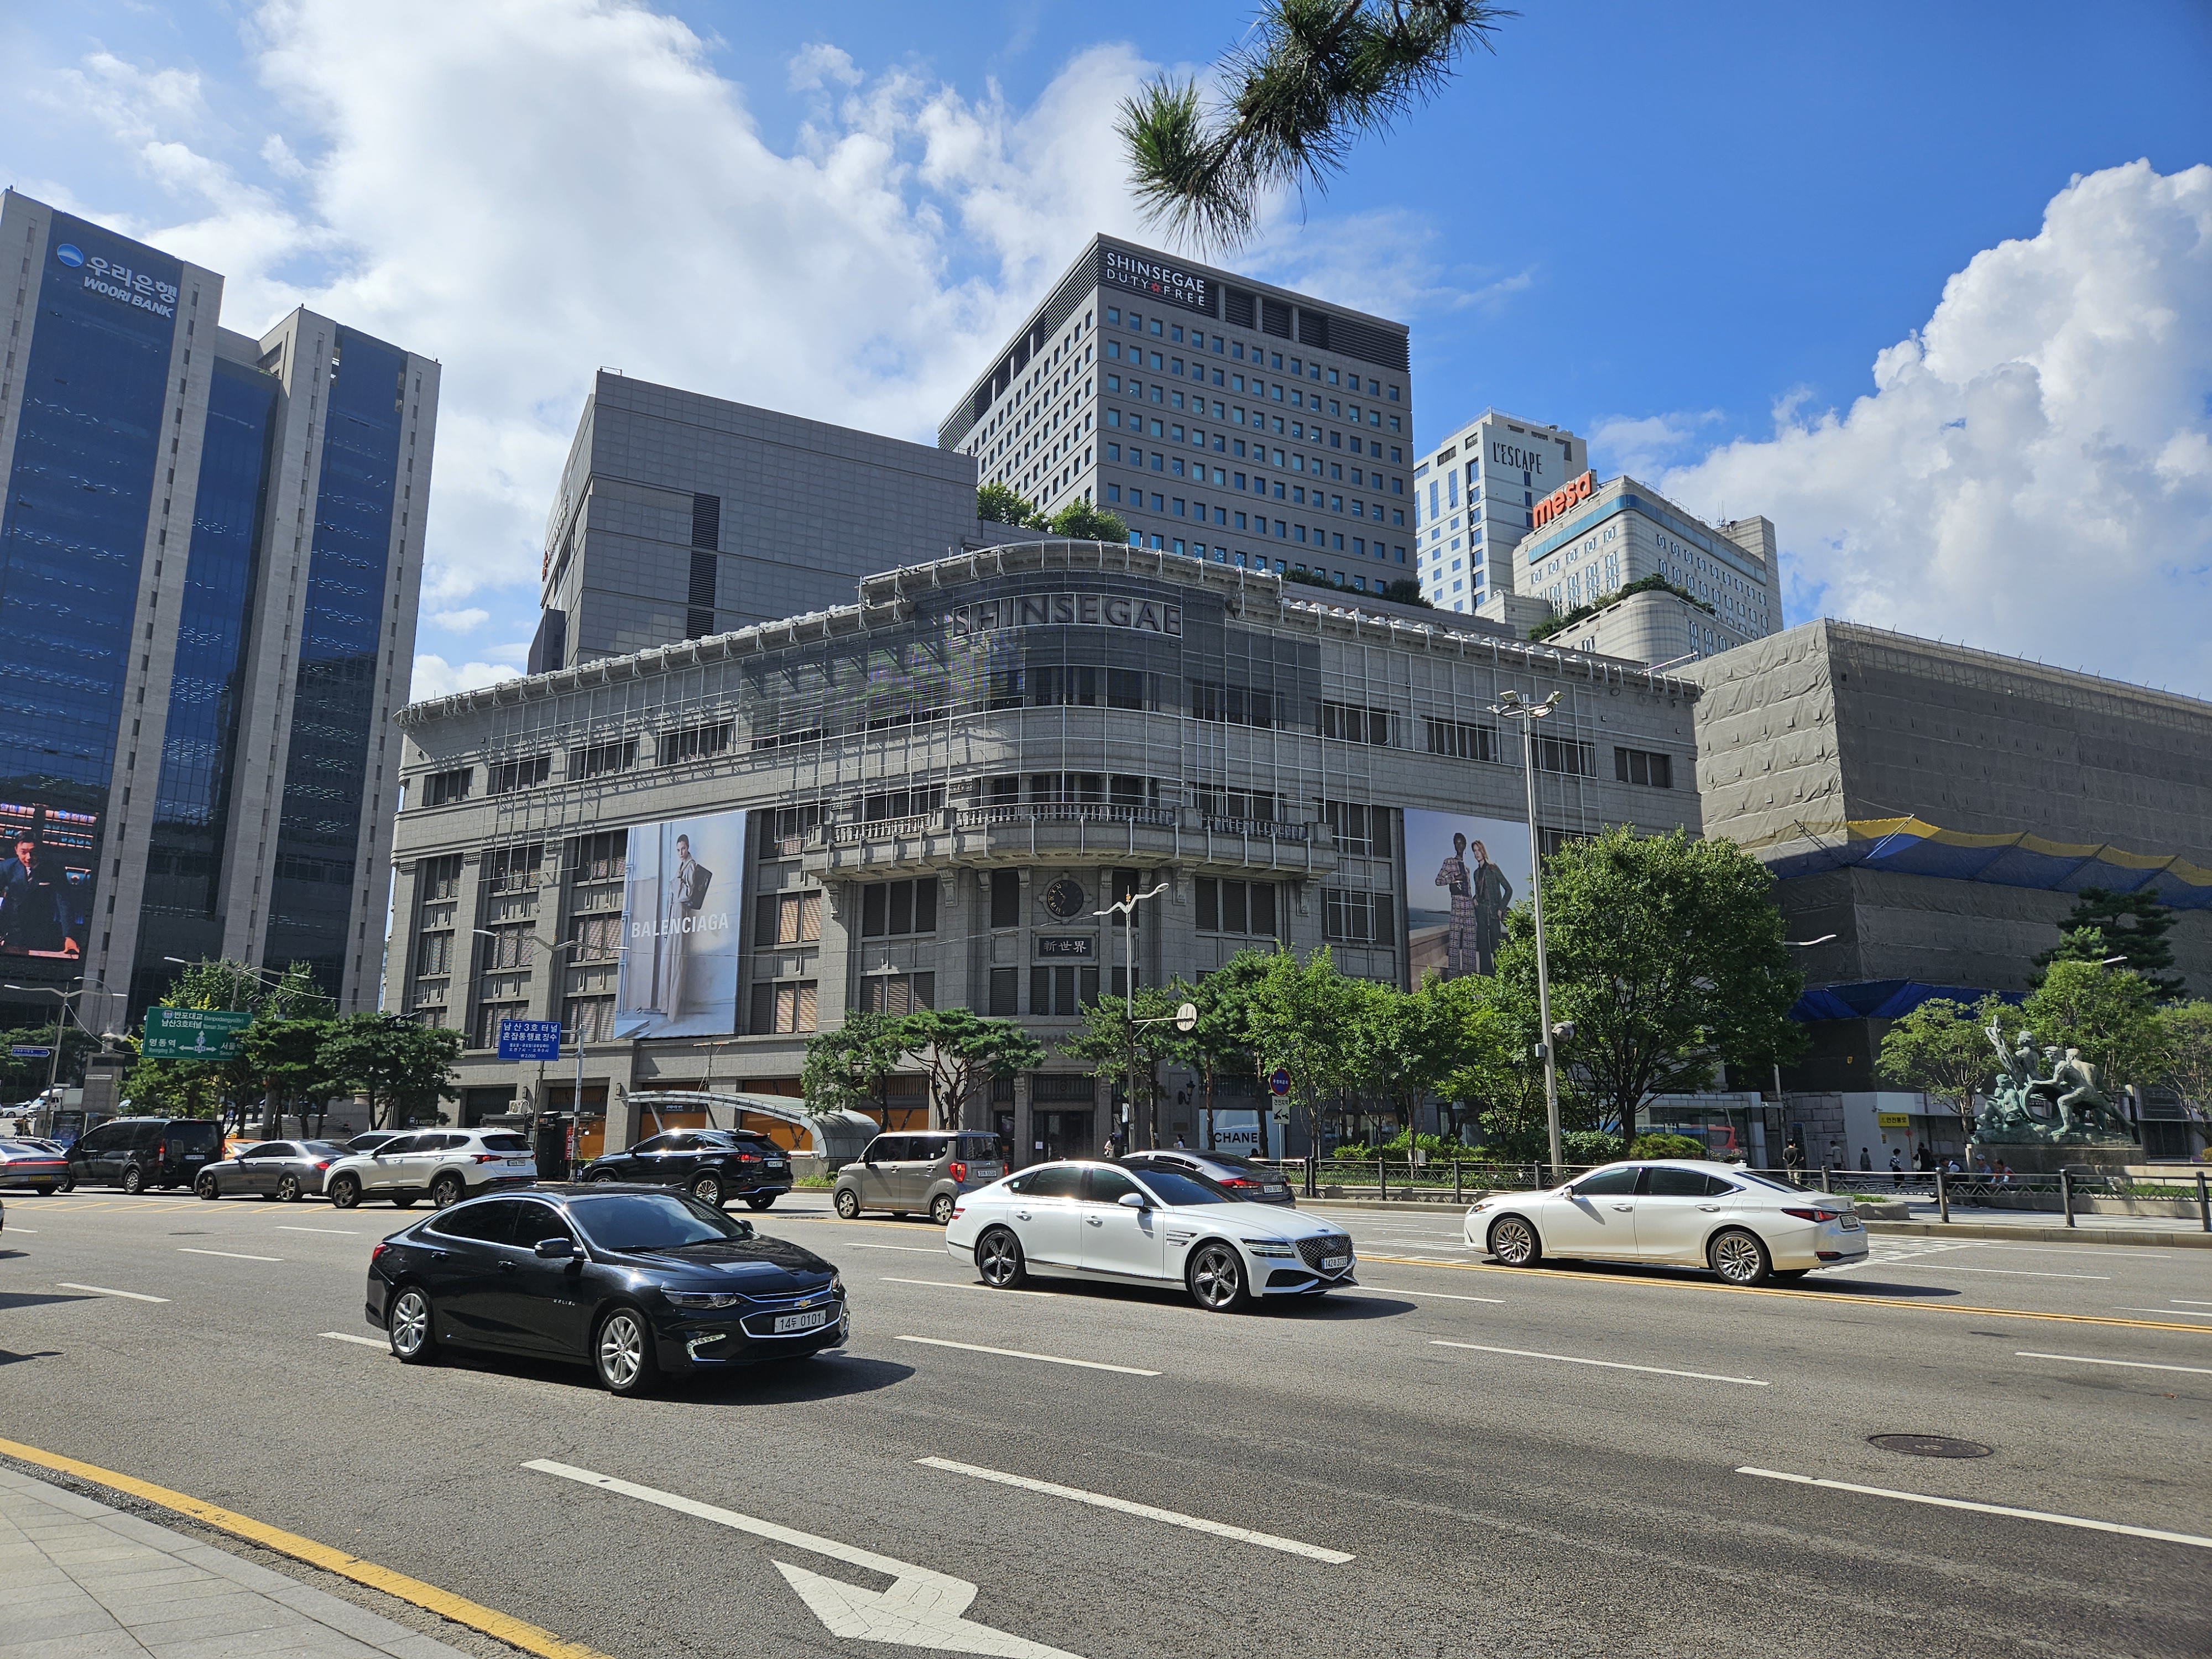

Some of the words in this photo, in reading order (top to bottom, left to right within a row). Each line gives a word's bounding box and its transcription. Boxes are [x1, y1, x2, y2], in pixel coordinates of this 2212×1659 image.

[87, 257, 178, 303] 우리은행
[1107, 252, 1204, 294] SHINSEGAE
[84, 276, 132, 302] WOORI
[132, 294, 174, 318] BANK
[1107, 268, 1149, 289] DUTY
[1164, 285, 1204, 306] FREE
[1493, 441, 1542, 474] L'ESCAPE
[1533, 472, 1591, 529] mesa
[955, 593, 1181, 635] SHINSEGAE
[631, 912, 729, 938] BALENCIAGA
[1044, 940, 1087, 953] 新世界
[161, 1019, 202, 1029] 남산3호터널
[174, 1011, 202, 1020] 반포대교
[149, 1039, 176, 1047] 명동역
[503, 1032, 557, 1042] 혼잡통행료징수
[1214, 1132, 1258, 1143] CHANE
[780, 1318, 796, 1330] 14두
[801, 1313, 821, 1326] 0101
